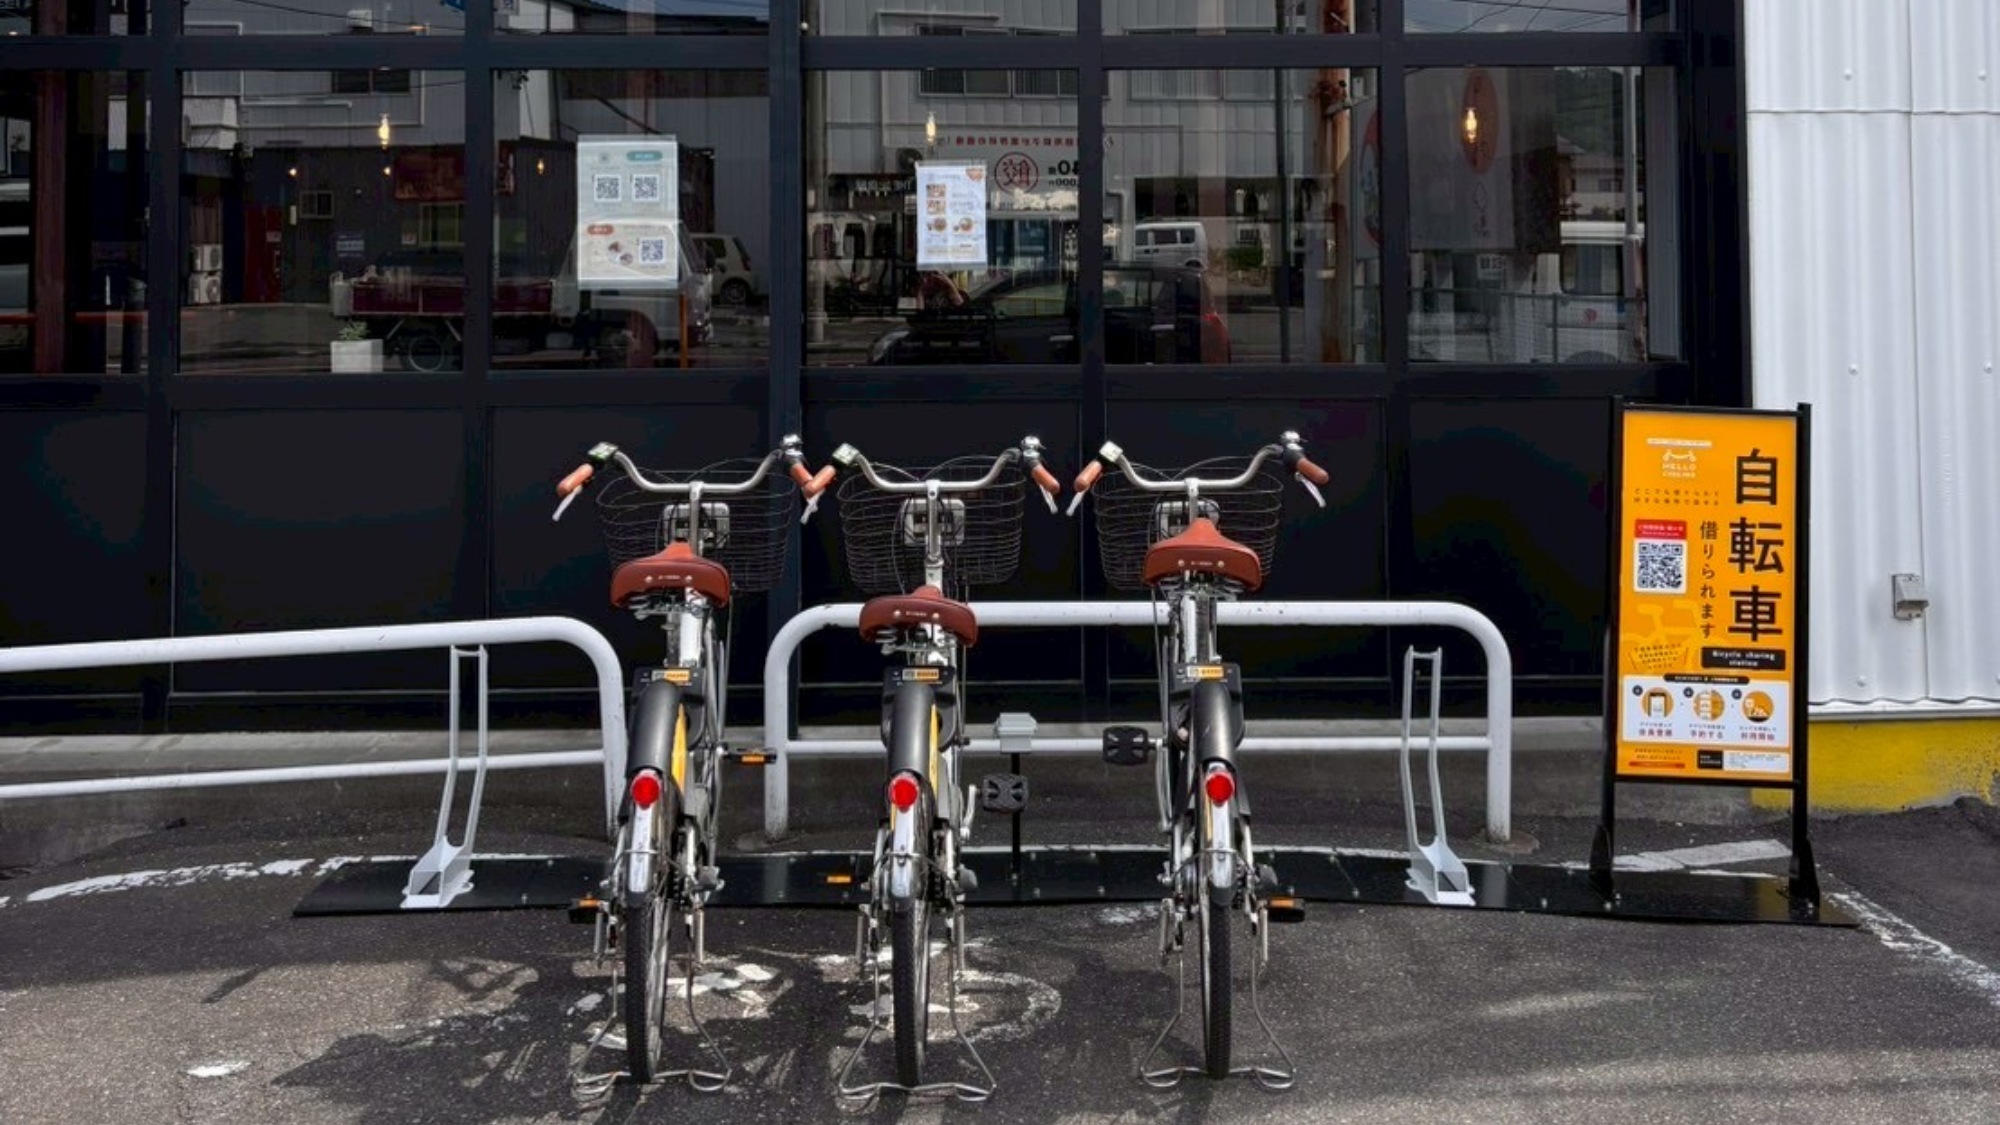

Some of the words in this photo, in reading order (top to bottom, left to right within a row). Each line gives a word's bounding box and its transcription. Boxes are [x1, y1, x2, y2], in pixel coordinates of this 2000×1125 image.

[1662, 463, 1697, 471] HELLO
[1728, 448, 1784, 642] 自転車
[1700, 520, 1718, 639] 借りられます
[1712, 650, 1742, 659] Bicycle
[1745, 651, 1775, 661] sharing
